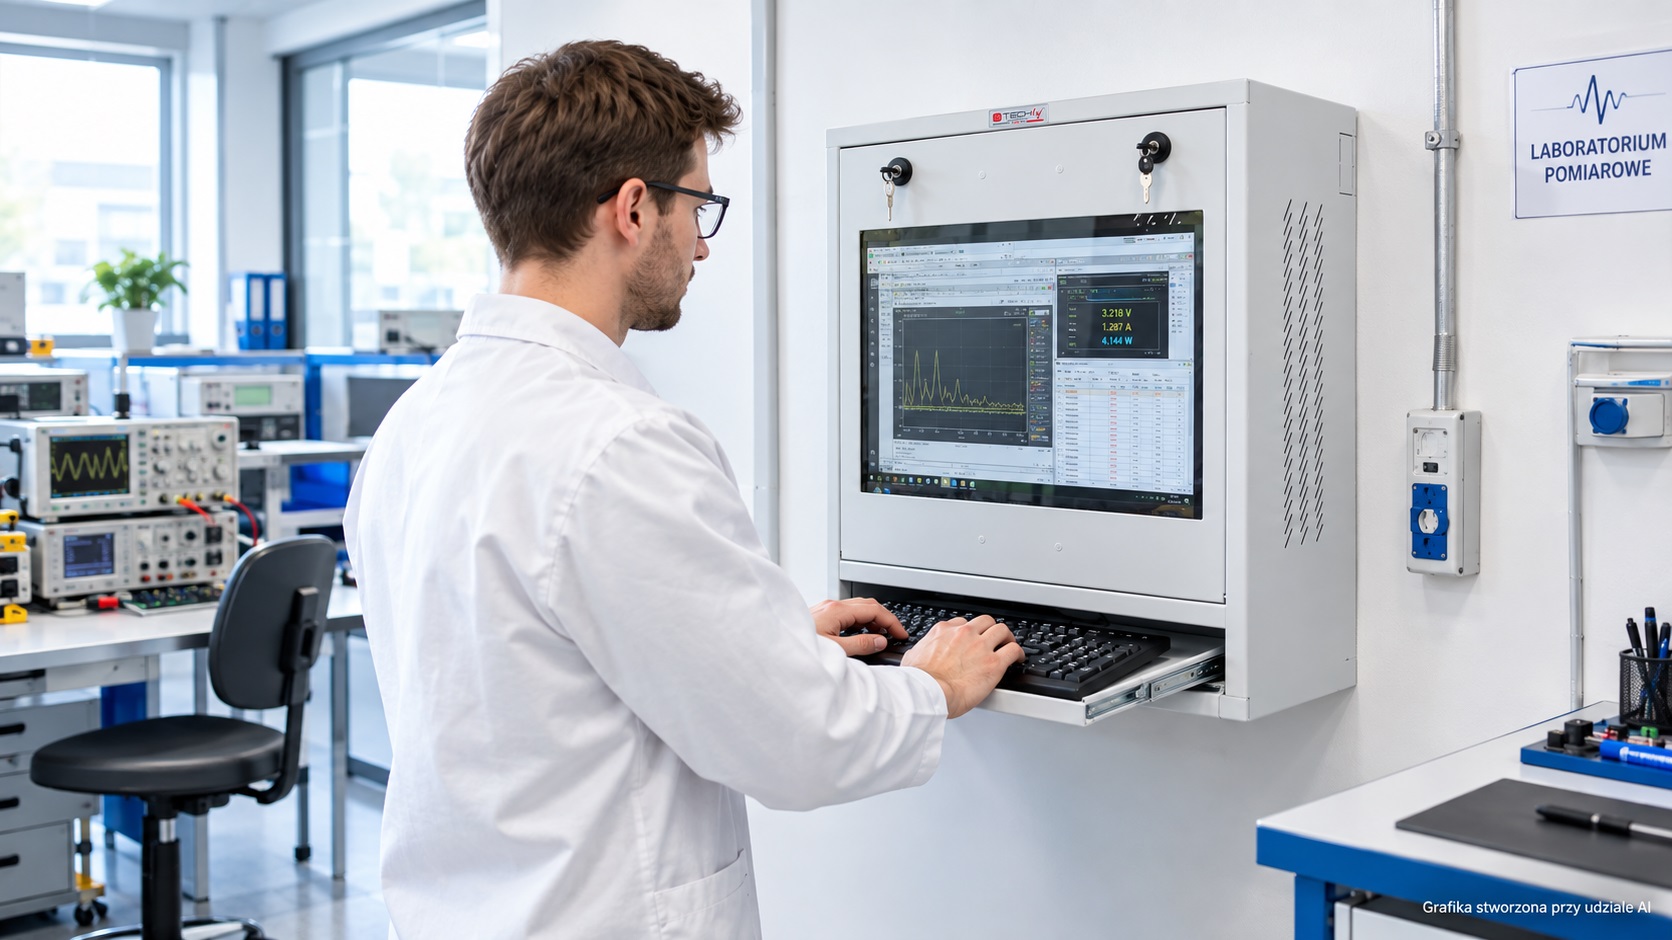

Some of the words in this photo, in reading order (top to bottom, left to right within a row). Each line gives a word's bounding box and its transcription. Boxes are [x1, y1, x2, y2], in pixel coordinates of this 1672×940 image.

[1531, 132, 1667, 160] LABORATORIUM
[1545, 159, 1652, 183] POMIAROWE
[1101, 308, 1124, 318] 3.218
[1125, 308, 1132, 318] V
[1101, 322, 1123, 331] 1.287
[1125, 322, 1132, 331] A
[1101, 336, 1123, 345] 4.144
[1124, 336, 1133, 345] W
